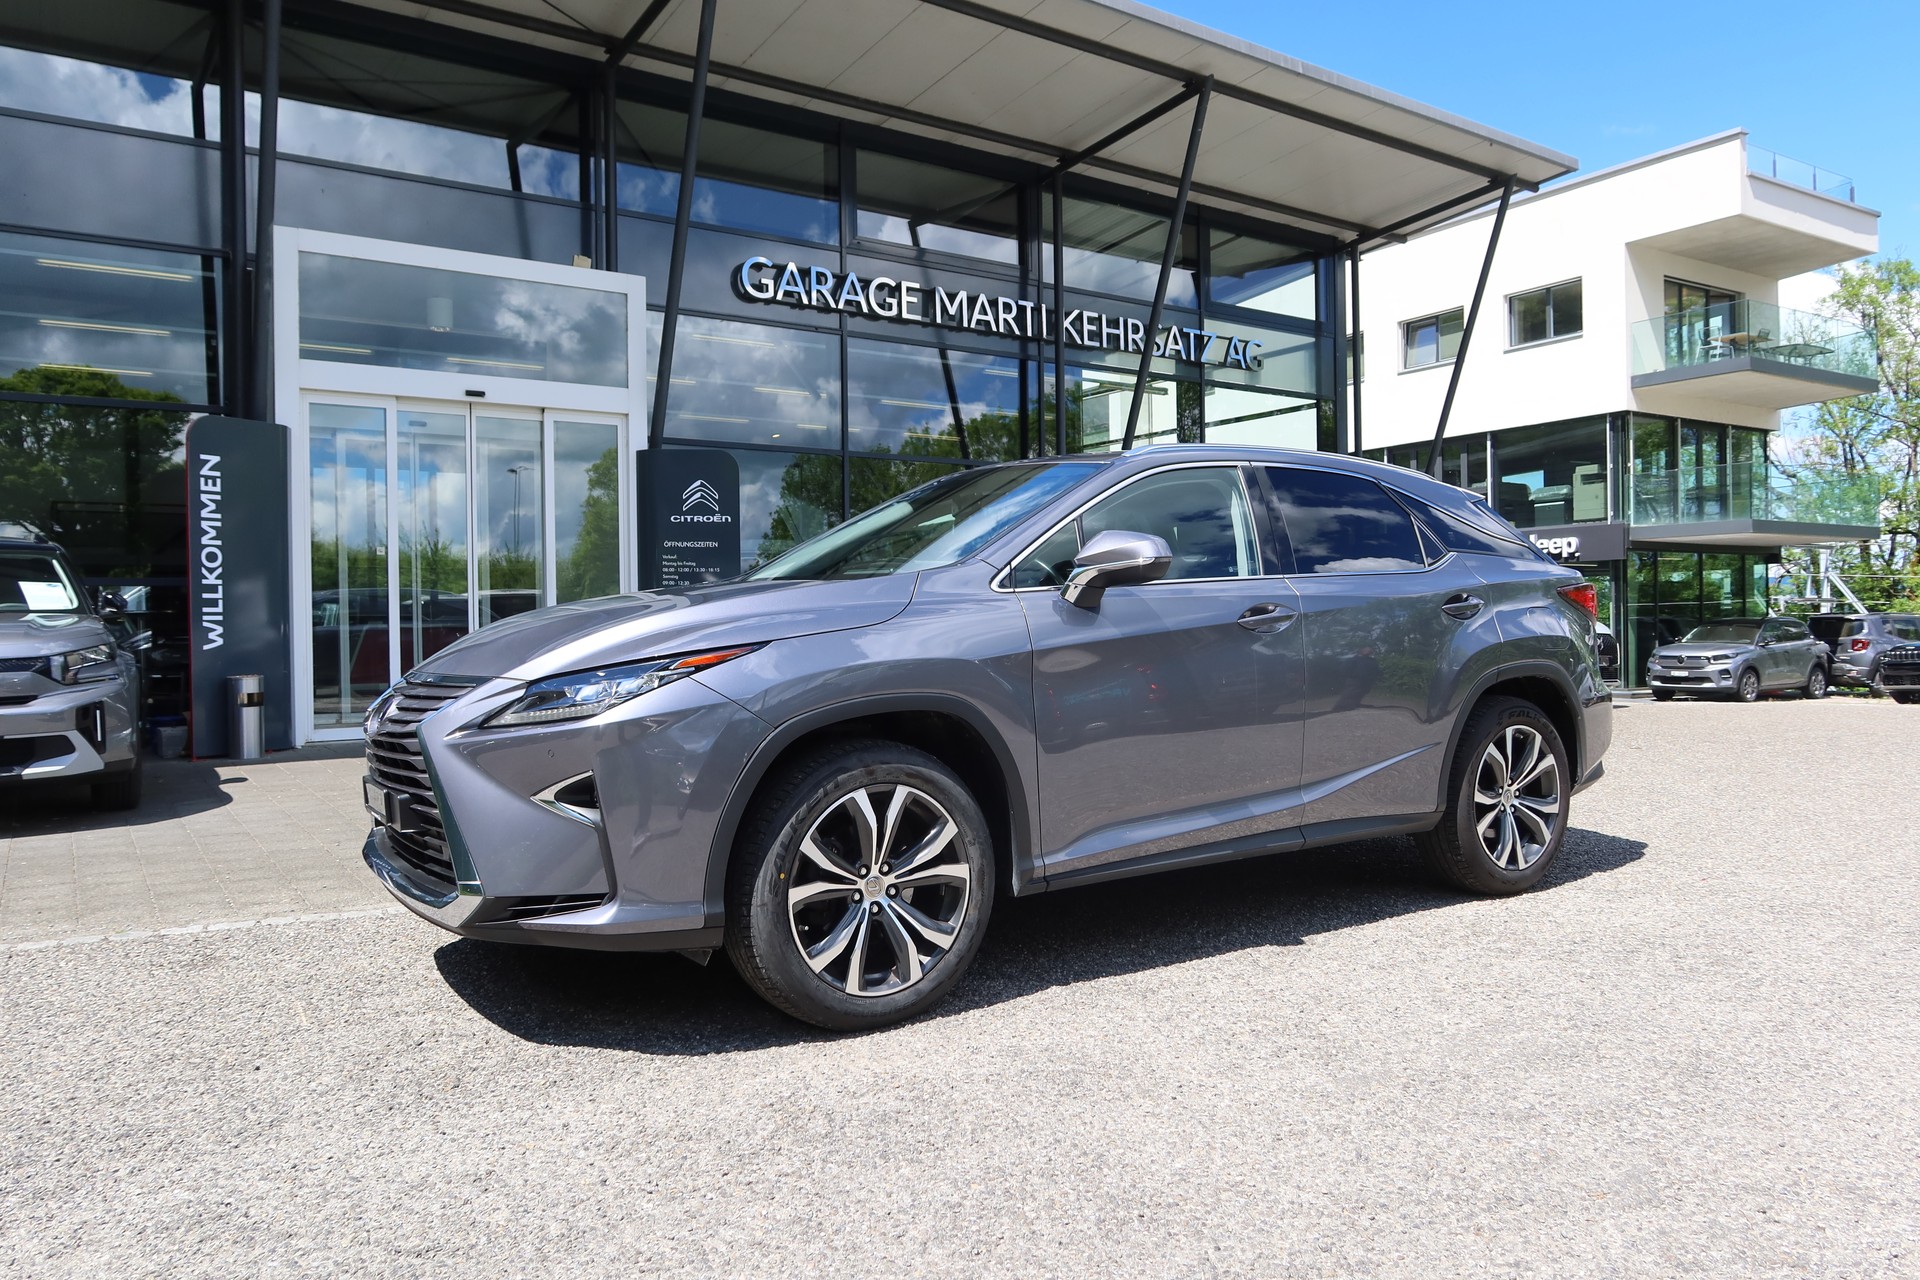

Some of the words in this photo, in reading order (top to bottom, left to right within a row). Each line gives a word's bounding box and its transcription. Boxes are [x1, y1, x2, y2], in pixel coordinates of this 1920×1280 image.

[740, 256, 922, 322] GARAGE
[934, 286, 1047, 339] MARTI
[1063, 309, 1217, 363] KEHRSATZ
[1226, 335, 1265, 373] AG
[199, 453, 224, 650] WILLKOMMEN
